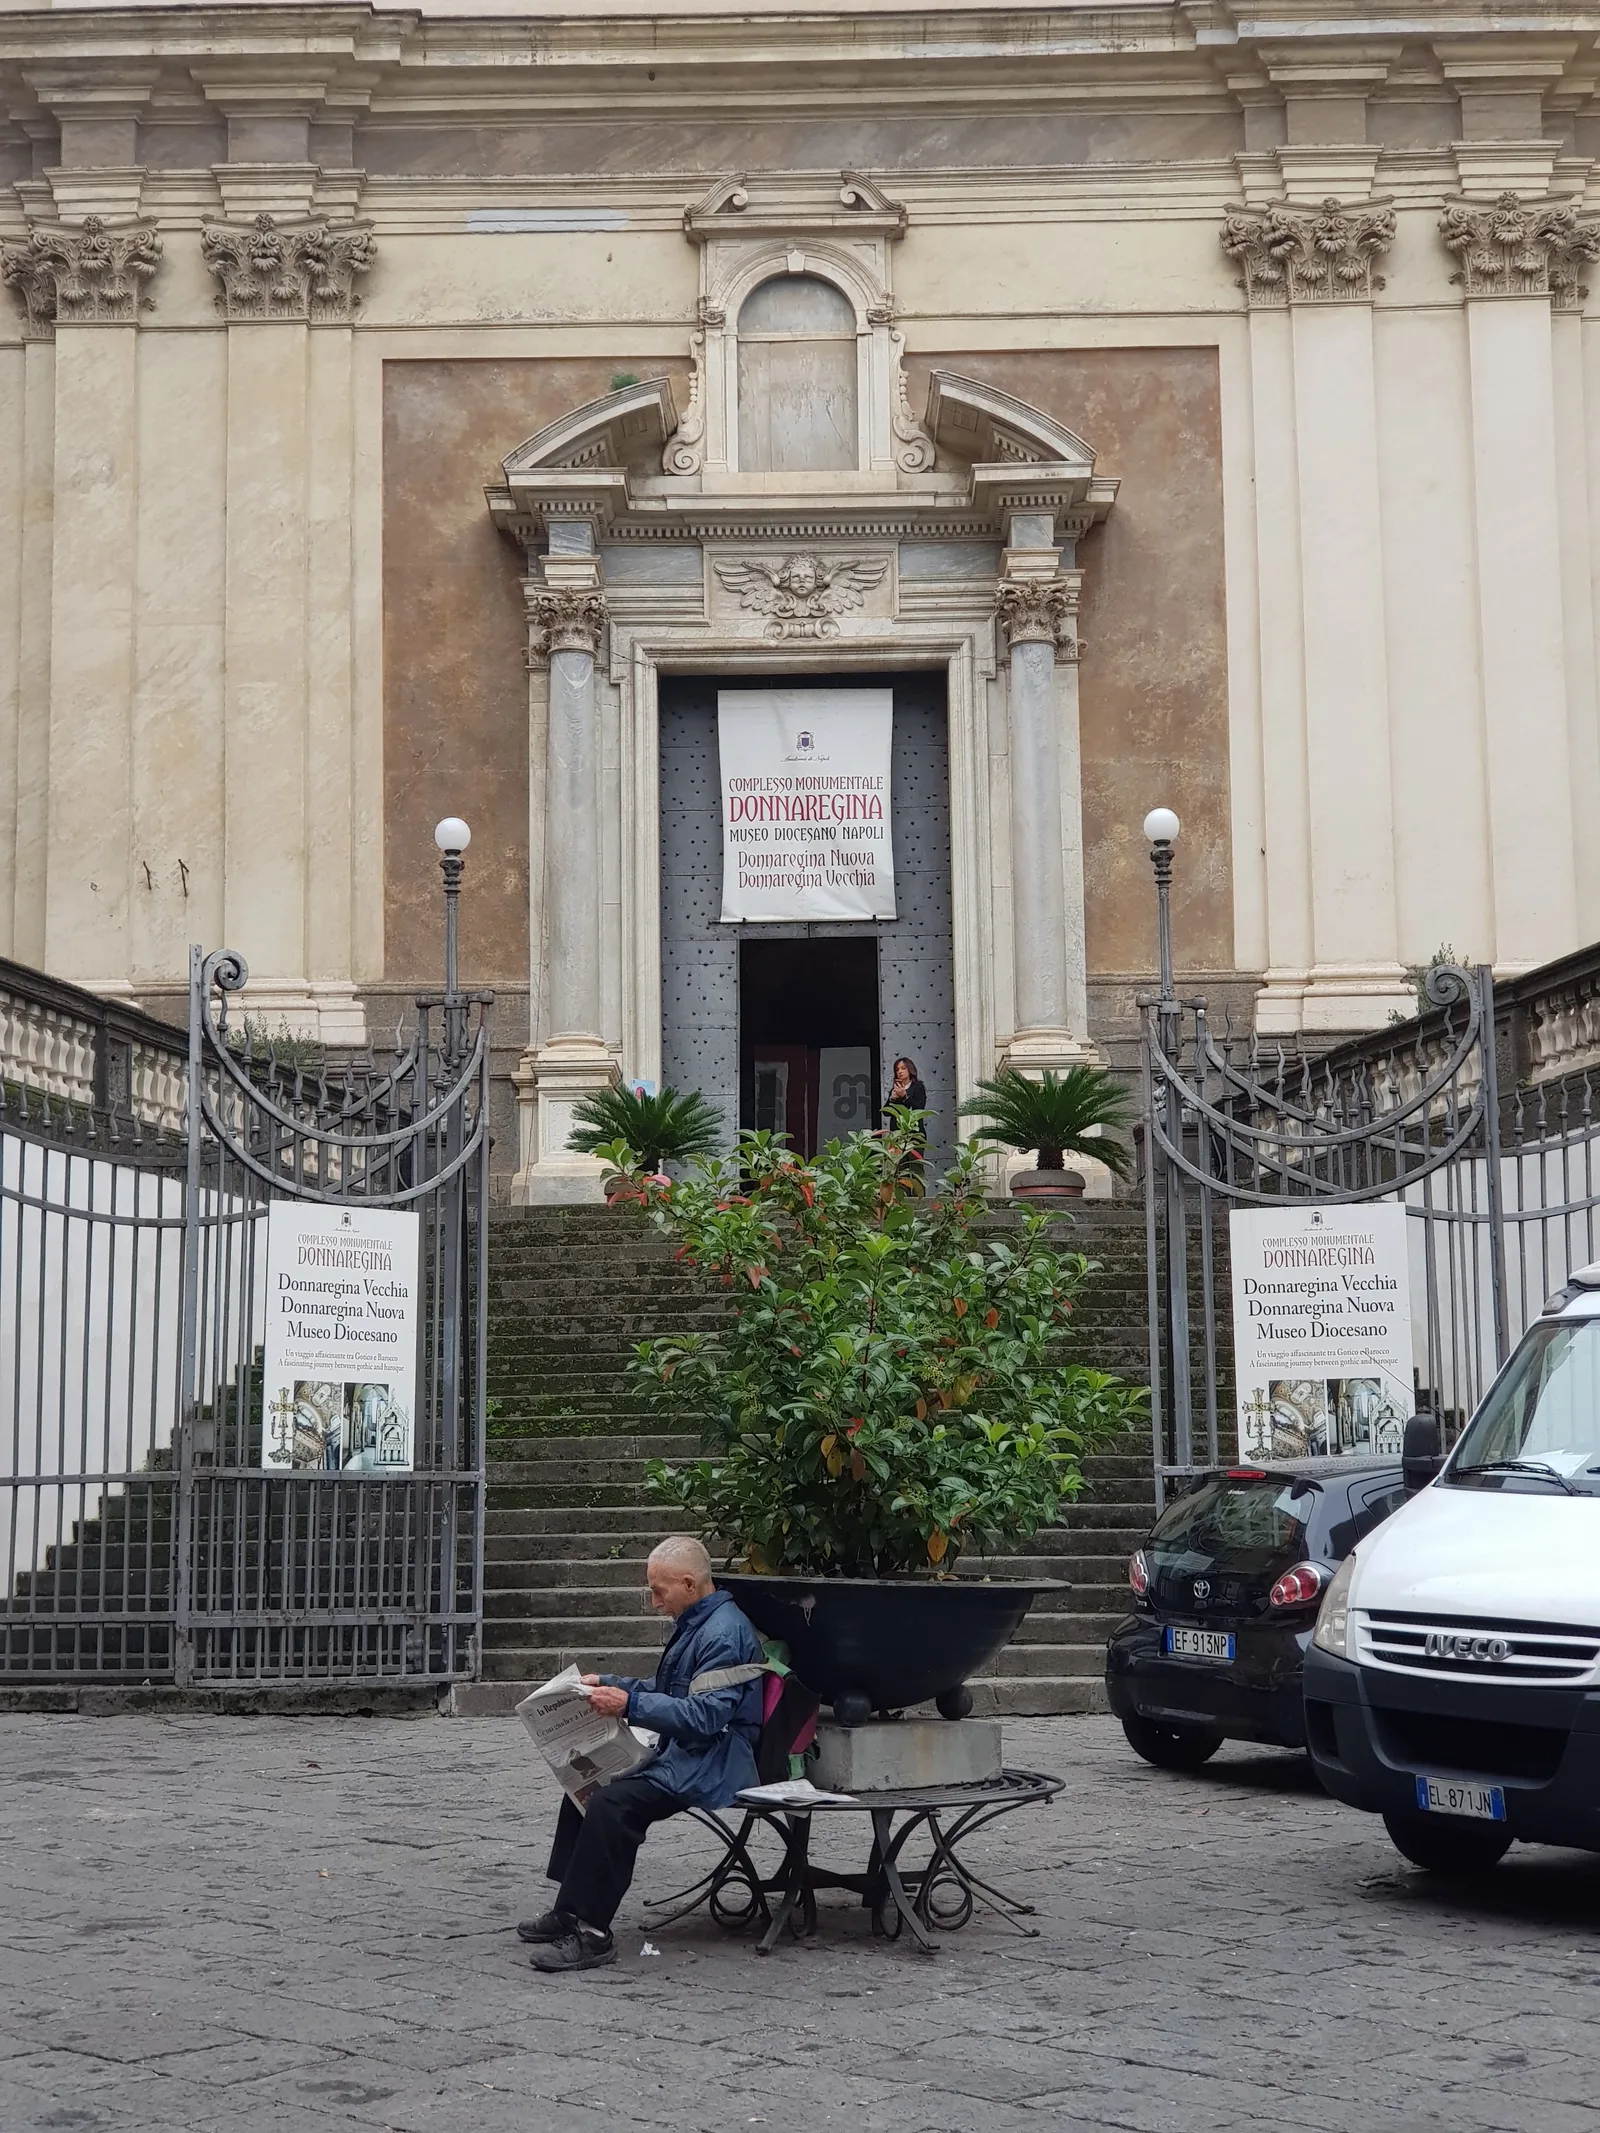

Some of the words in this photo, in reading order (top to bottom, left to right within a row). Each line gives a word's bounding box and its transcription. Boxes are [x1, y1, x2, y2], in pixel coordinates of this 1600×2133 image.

[729, 777, 793, 793] COMPLESSO
[796, 776, 883, 791] MONUMENTALE
[729, 794, 883, 826] DONNAREGINA
[730, 828, 768, 844] MUSEO
[775, 826, 836, 843] DIOCESANO
[842, 826, 884, 840] NAPOLI
[738, 850, 826, 872] Donnaregina
[831, 850, 875, 867] Nuova
[739, 871, 822, 895] Donnaregina
[826, 869, 875, 888] Vecchia
[298, 1233, 338, 1248] COMPLESSO
[340, 1237, 392, 1250] MONUMENTALE
[1262, 1236, 1308, 1248] COMPLESSO
[1311, 1234, 1375, 1246] MONUMENTALE
[298, 1246, 392, 1273] DONNAREGINA
[1263, 1247, 1375, 1269] DONNAREGINA
[278, 1273, 360, 1299] Donnaregina
[363, 1279, 408, 1298] Vecchia
[1243, 1277, 1338, 1298] Donnaregina
[1341, 1274, 1398, 1291] Vecchia
[281, 1296, 363, 1322] Donnaregina
[366, 1301, 404, 1320] Nuova
[1248, 1299, 1343, 1320] Donnaregina
[1346, 1296, 1395, 1313] Nuova
[286, 1320, 331, 1339] Museo
[334, 1322, 398, 1343] Diocesano
[1257, 1322, 1307, 1340] Museo
[1310, 1321, 1387, 1338] Diocesano
[285, 1349, 294, 1357] Un
[295, 1350, 314, 1359] viaggio
[355, 1352, 373, 1360] Gotico
[378, 1353, 398, 1362] Barocco
[1256, 1350, 1266, 1358] Un
[1267, 1350, 1289, 1359] viaggio
[1290, 1349, 1325, 1358] affascinante
[1337, 1347, 1358, 1356] Gotico
[1364, 1347, 1390, 1355] Barocco
[1256, 1359, 1289, 1369] fascinating
[1289, 1359, 1313, 1369] journey
[1314, 1358, 1339, 1366] between
[1340, 1357, 1359, 1367] gothic
[1360, 1357, 1372, 1365] and
[1373, 1357, 1399, 1367] baroque
[278, 1358, 283, 1366] A
[284, 1359, 313, 1368] fascinating
[313, 1361, 333, 1370] journey
[334, 1361, 356, 1369] between
[357, 1362, 373, 1371] gothic
[374, 1363, 383, 1371] and
[384, 1363, 405, 1374] baroque
[1192, 1633, 1227, 1655] 913NP
[1425, 1633, 1508, 1661] IVECO
